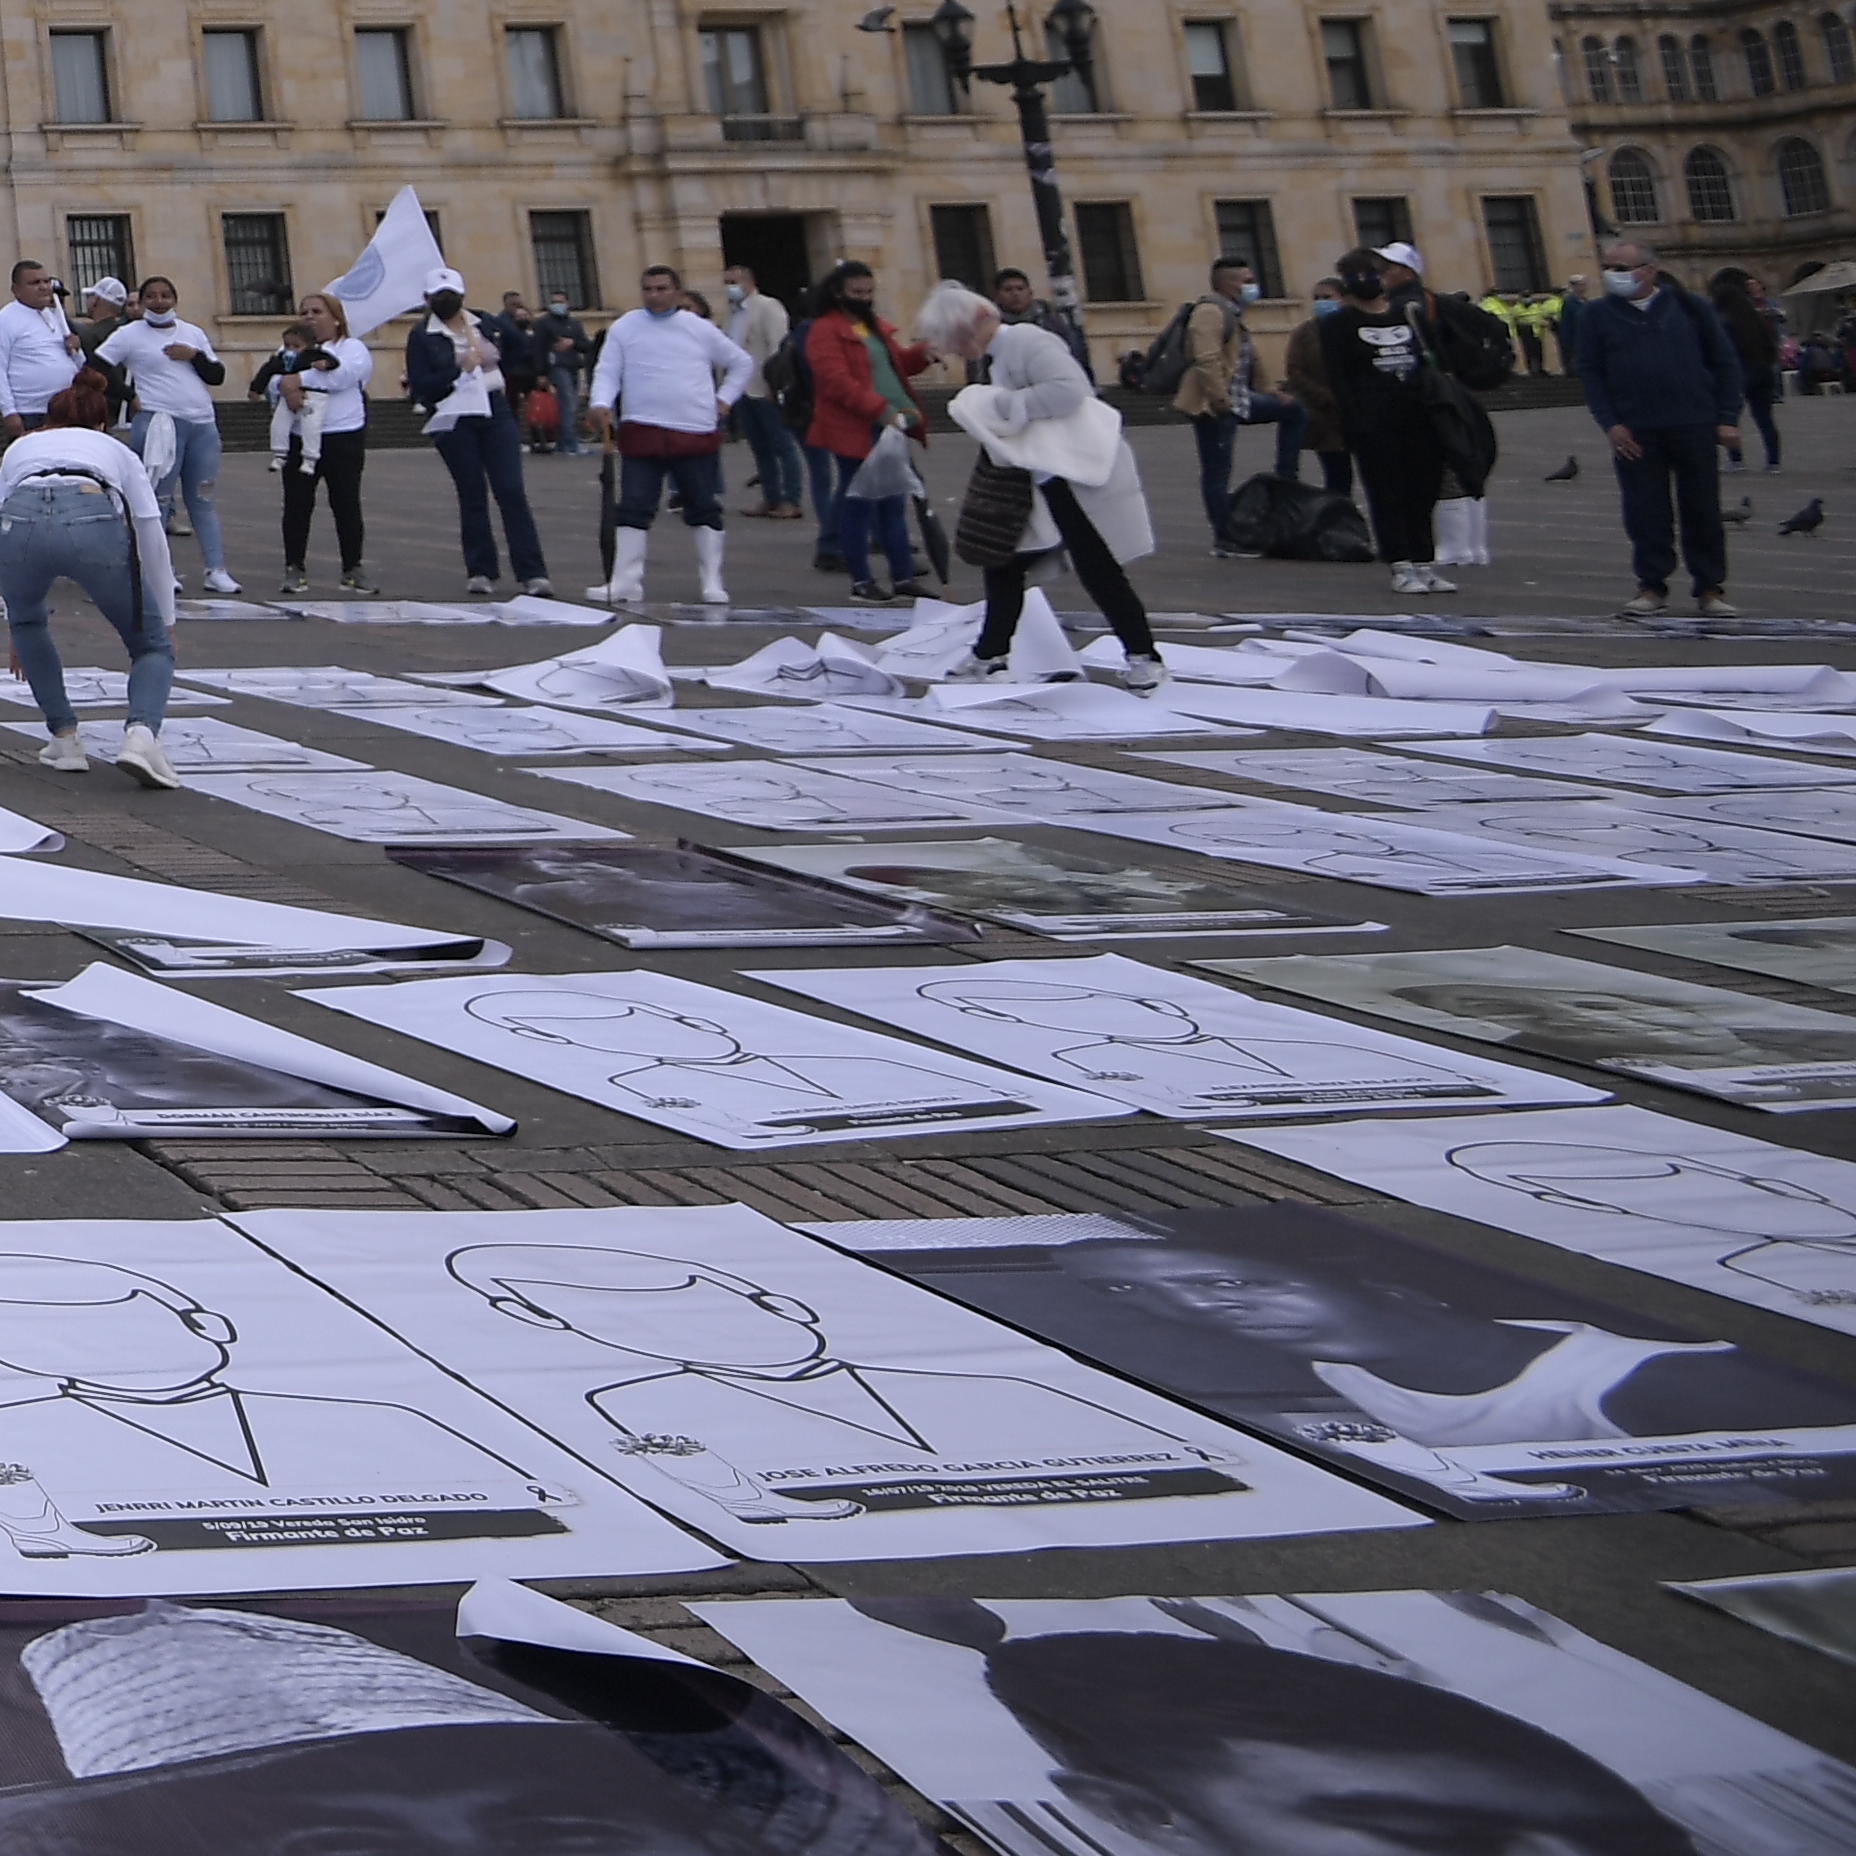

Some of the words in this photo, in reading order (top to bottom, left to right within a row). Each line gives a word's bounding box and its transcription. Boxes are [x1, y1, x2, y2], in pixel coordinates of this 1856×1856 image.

[756, 1468, 820, 1483] JOSE
[824, 1462, 939, 1477] ALFREDO
[941, 1459, 1037, 1474] GARCIA
[1041, 1451, 1180, 1469] GUTIERREZ
[93, 1501, 171, 1514] JENRRI
[175, 1497, 265, 1511] MARTIN
[267, 1494, 377, 1508] CASTILLO
[380, 1491, 489, 1504] DELGADO
[926, 1490, 1038, 1505] Firmante
[1040, 1489, 1071, 1501] de
[1074, 1487, 1122, 1500] Paz
[269, 1517, 338, 1529] Vereda
[337, 1516, 374, 1527] San
[374, 1514, 427, 1525] Isidro
[223, 1528, 341, 1543] Firmante
[343, 1526, 378, 1538] de
[380, 1524, 430, 1537] Paz
